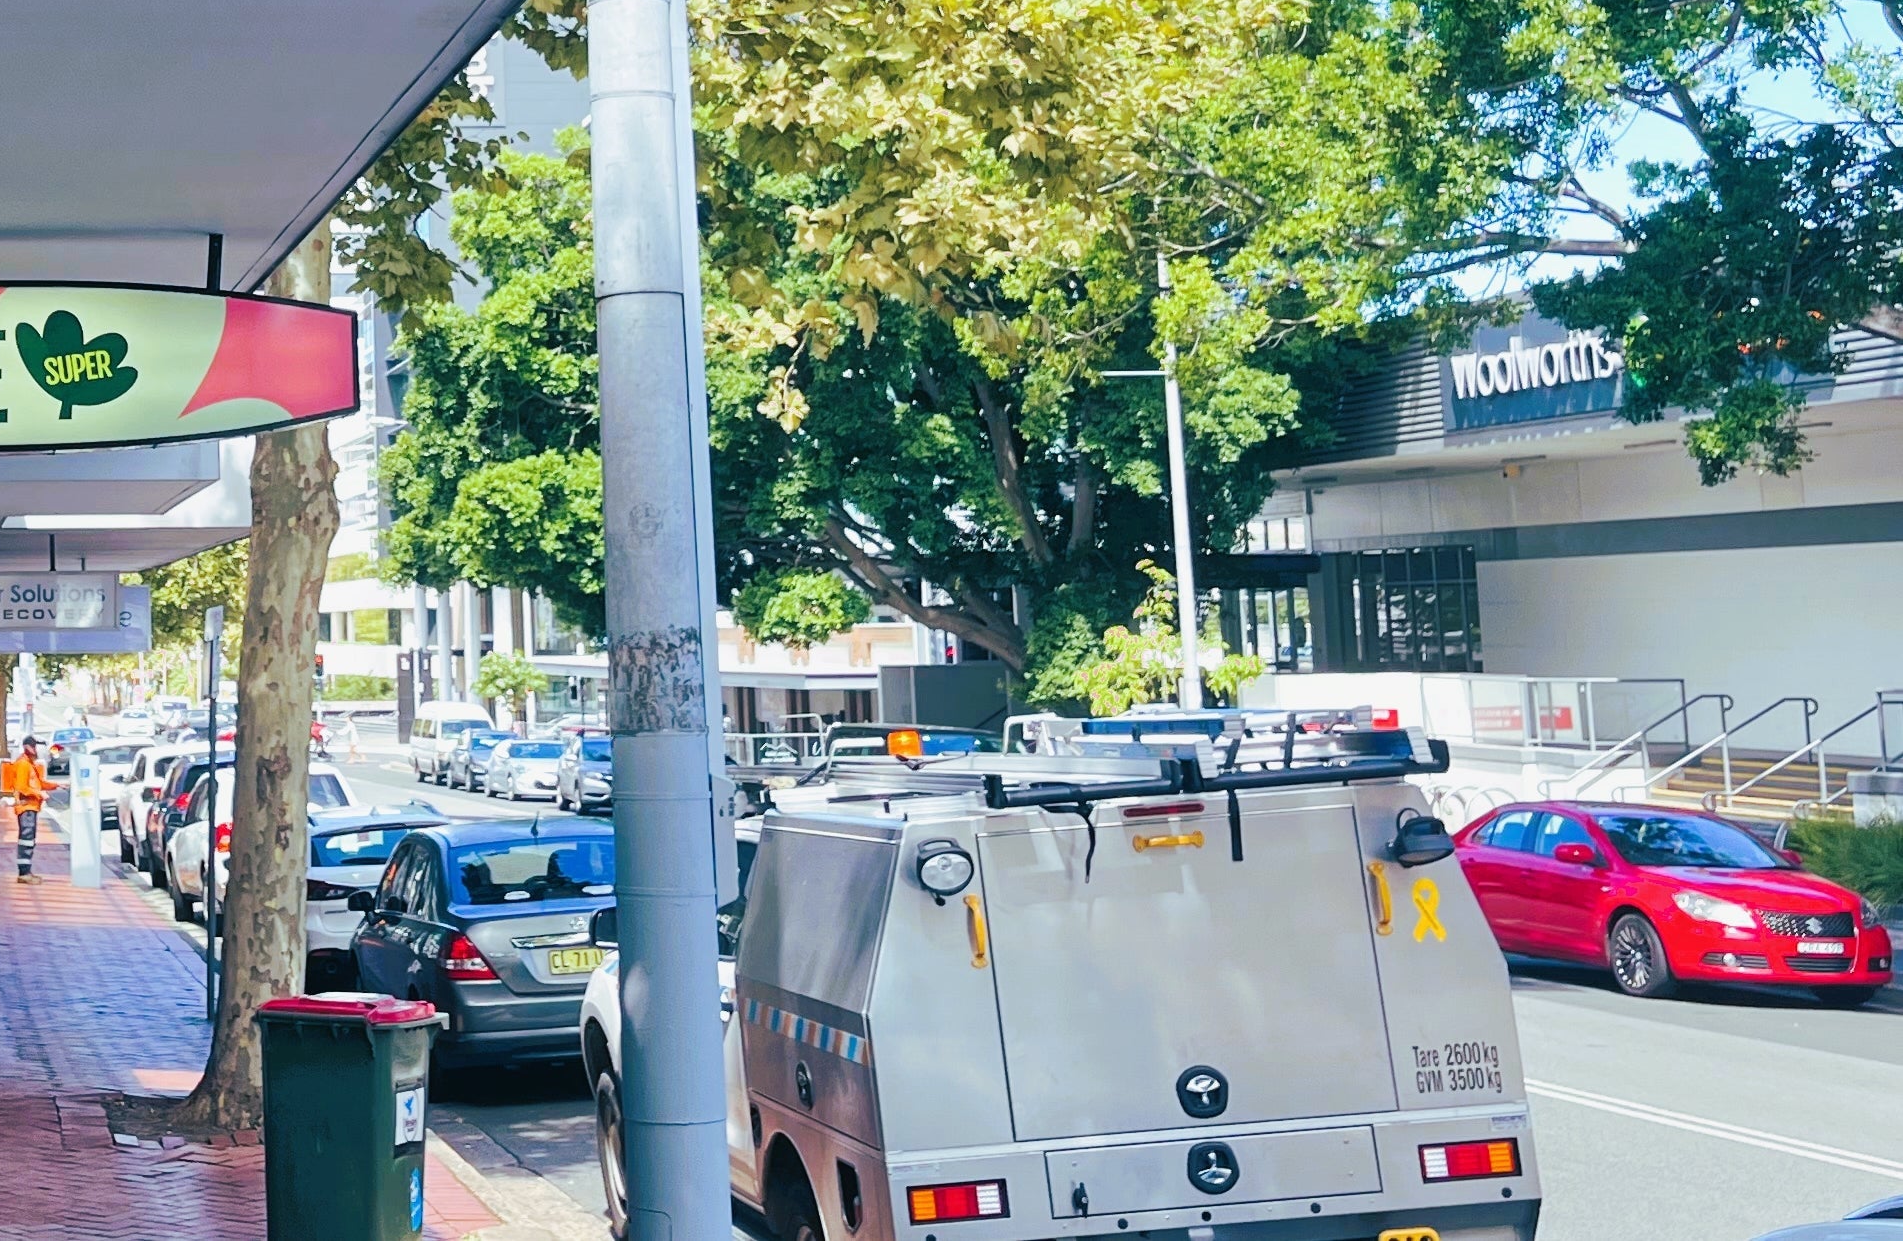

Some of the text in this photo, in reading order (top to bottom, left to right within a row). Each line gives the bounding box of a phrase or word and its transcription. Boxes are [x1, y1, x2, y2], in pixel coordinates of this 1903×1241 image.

[43, 349, 113, 386] SUPER
[1451, 329, 1624, 400] Woolworths
[1412, 1041, 1499, 1069] Tare 2600 kg
[1416, 1066, 1502, 1094] GVM 3500 kg
